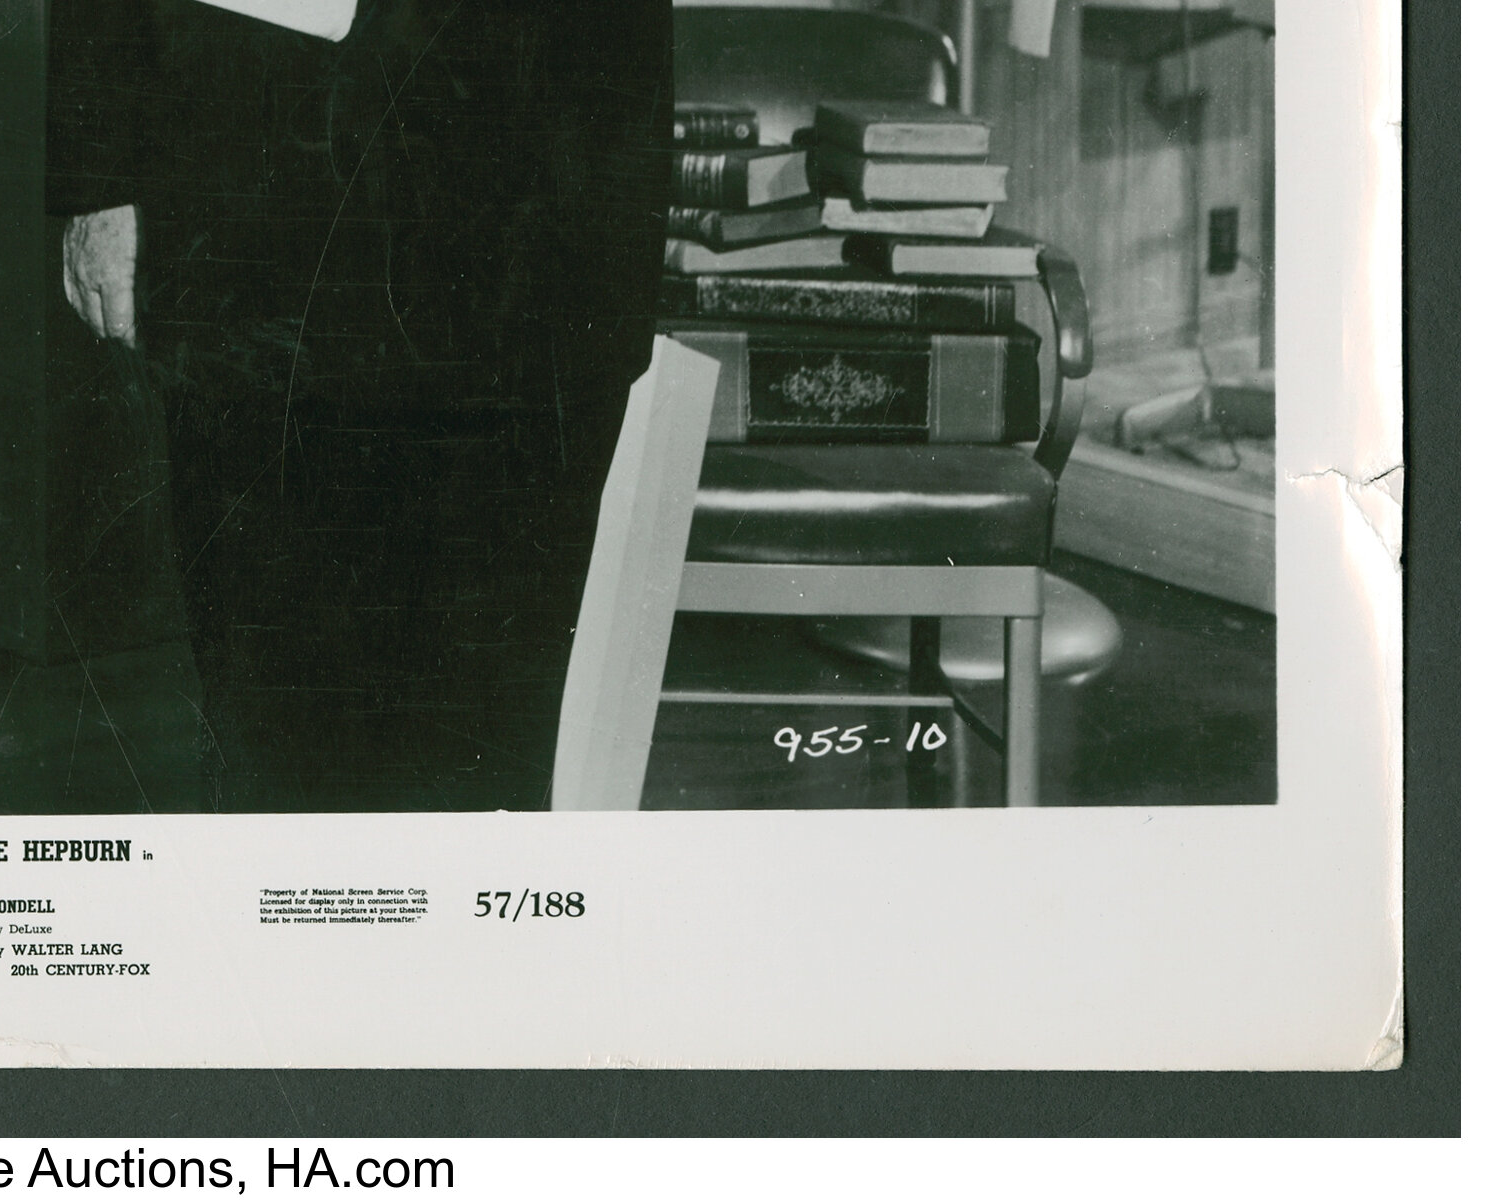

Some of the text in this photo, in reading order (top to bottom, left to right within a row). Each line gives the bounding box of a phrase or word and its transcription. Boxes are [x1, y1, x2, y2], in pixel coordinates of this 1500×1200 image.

[22, 839, 132, 863] HEPBURN
[142, 849, 154, 861] in
[299, 888, 309, 897] of
[311, 887, 345, 897] National
[347, 887, 374, 896] Screen
[376, 887, 405, 896] Service
[308, 898, 335, 906] display
[338, 898, 354, 906] only
[474, 887, 586, 923] 57/188
[341, 907, 367, 915] picture
[329, 916, 375, 924] immediately
[9, 924, 53, 935] DeLuxe
[11, 943, 74, 956] WALTER
[80, 943, 124, 956] LANG
[10, 964, 39, 977] 20th
[45, 963, 151, 976] CENTURY-FOX
